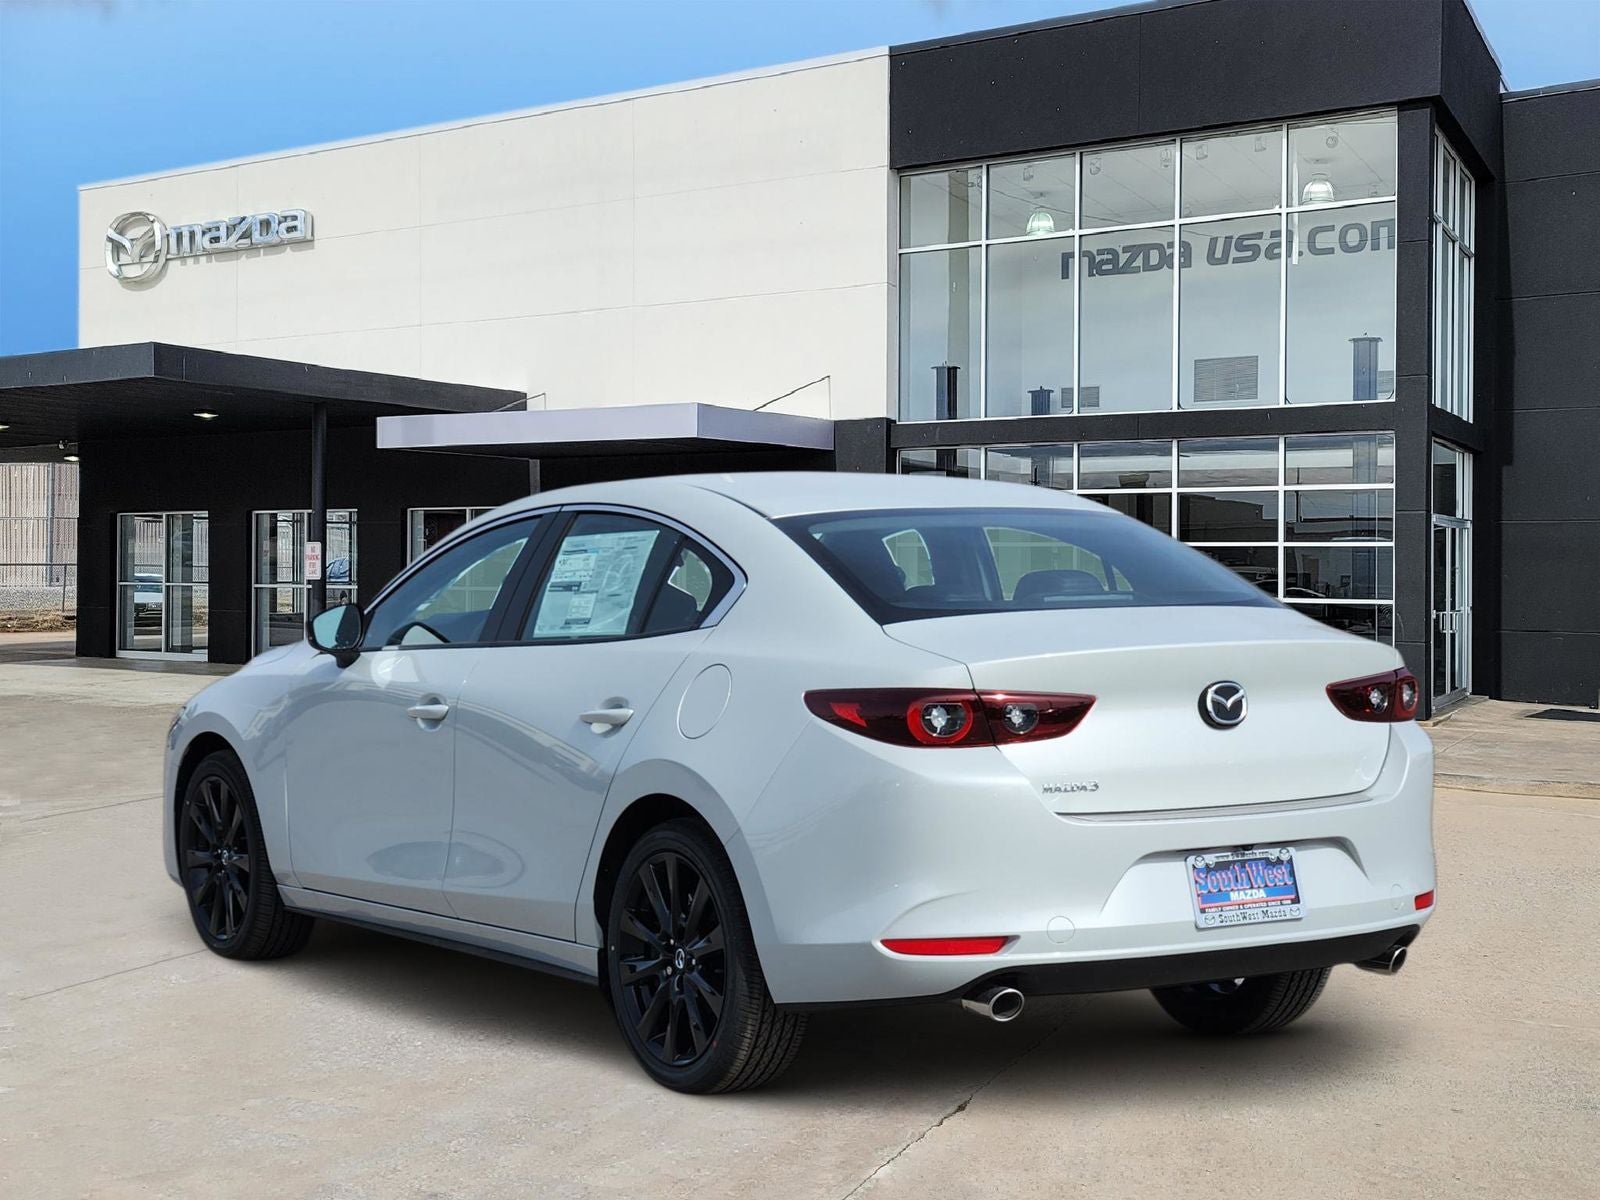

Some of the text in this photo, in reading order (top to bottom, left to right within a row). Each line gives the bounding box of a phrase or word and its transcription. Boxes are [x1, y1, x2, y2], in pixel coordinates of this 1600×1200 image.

[166, 209, 313, 256] mazda
[1061, 240, 1192, 280] mazda
[1230, 889, 1266, 901] MAZDA
[1219, 908, 1287, 923] SouthWest Mazda
